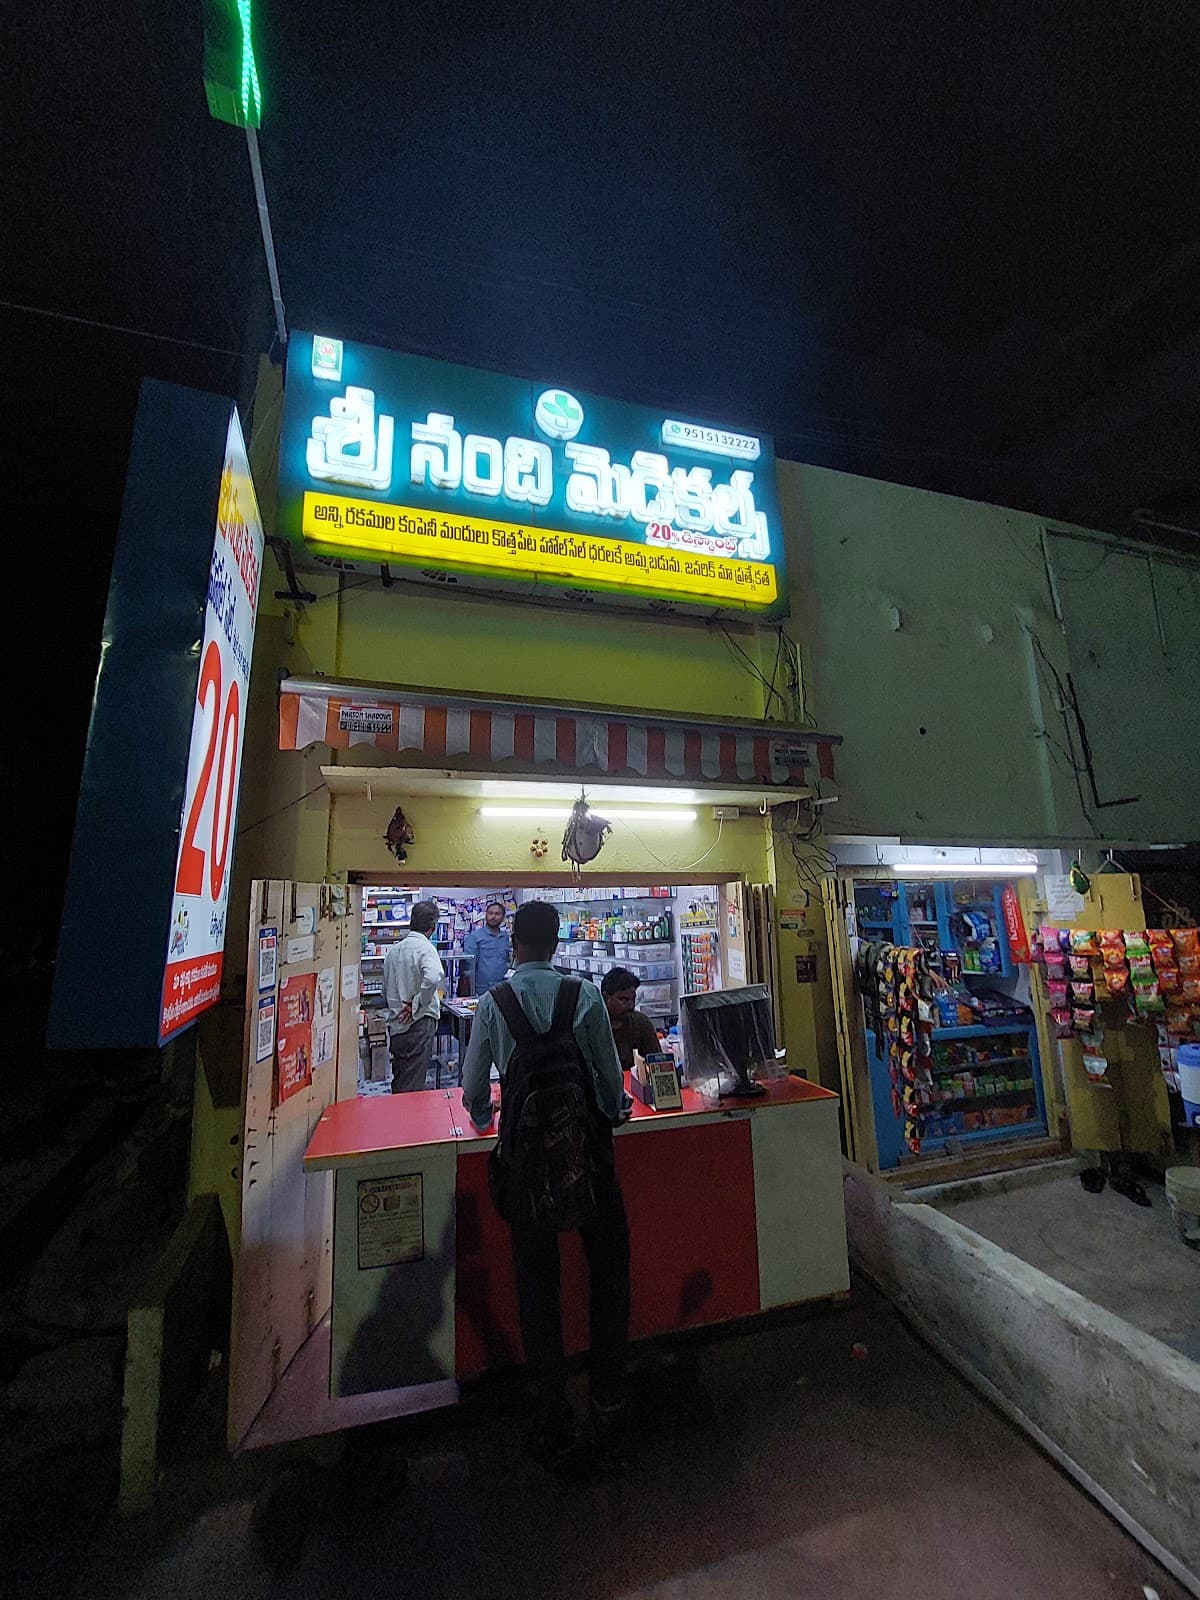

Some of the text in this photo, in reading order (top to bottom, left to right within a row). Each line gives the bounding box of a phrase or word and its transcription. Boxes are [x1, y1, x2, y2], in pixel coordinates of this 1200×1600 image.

[306, 386, 771, 560] శ్రీ నంది మెడికల్స్
[684, 427, 757, 451] 9515132222
[313, 504, 344, 529] అన్ని
[345, 506, 395, 531] రకముల
[398, 515, 437, 538] కంపెనీ
[439, 521, 490, 545] మందులు
[491, 529, 537, 555] కొత్తపేట
[588, 544, 623, 566] ధరలకే
[684, 560, 716, 578] జనరిక్
[718, 564, 733, 581] మా
[734, 565, 770, 591] ప్రత్యేకత
